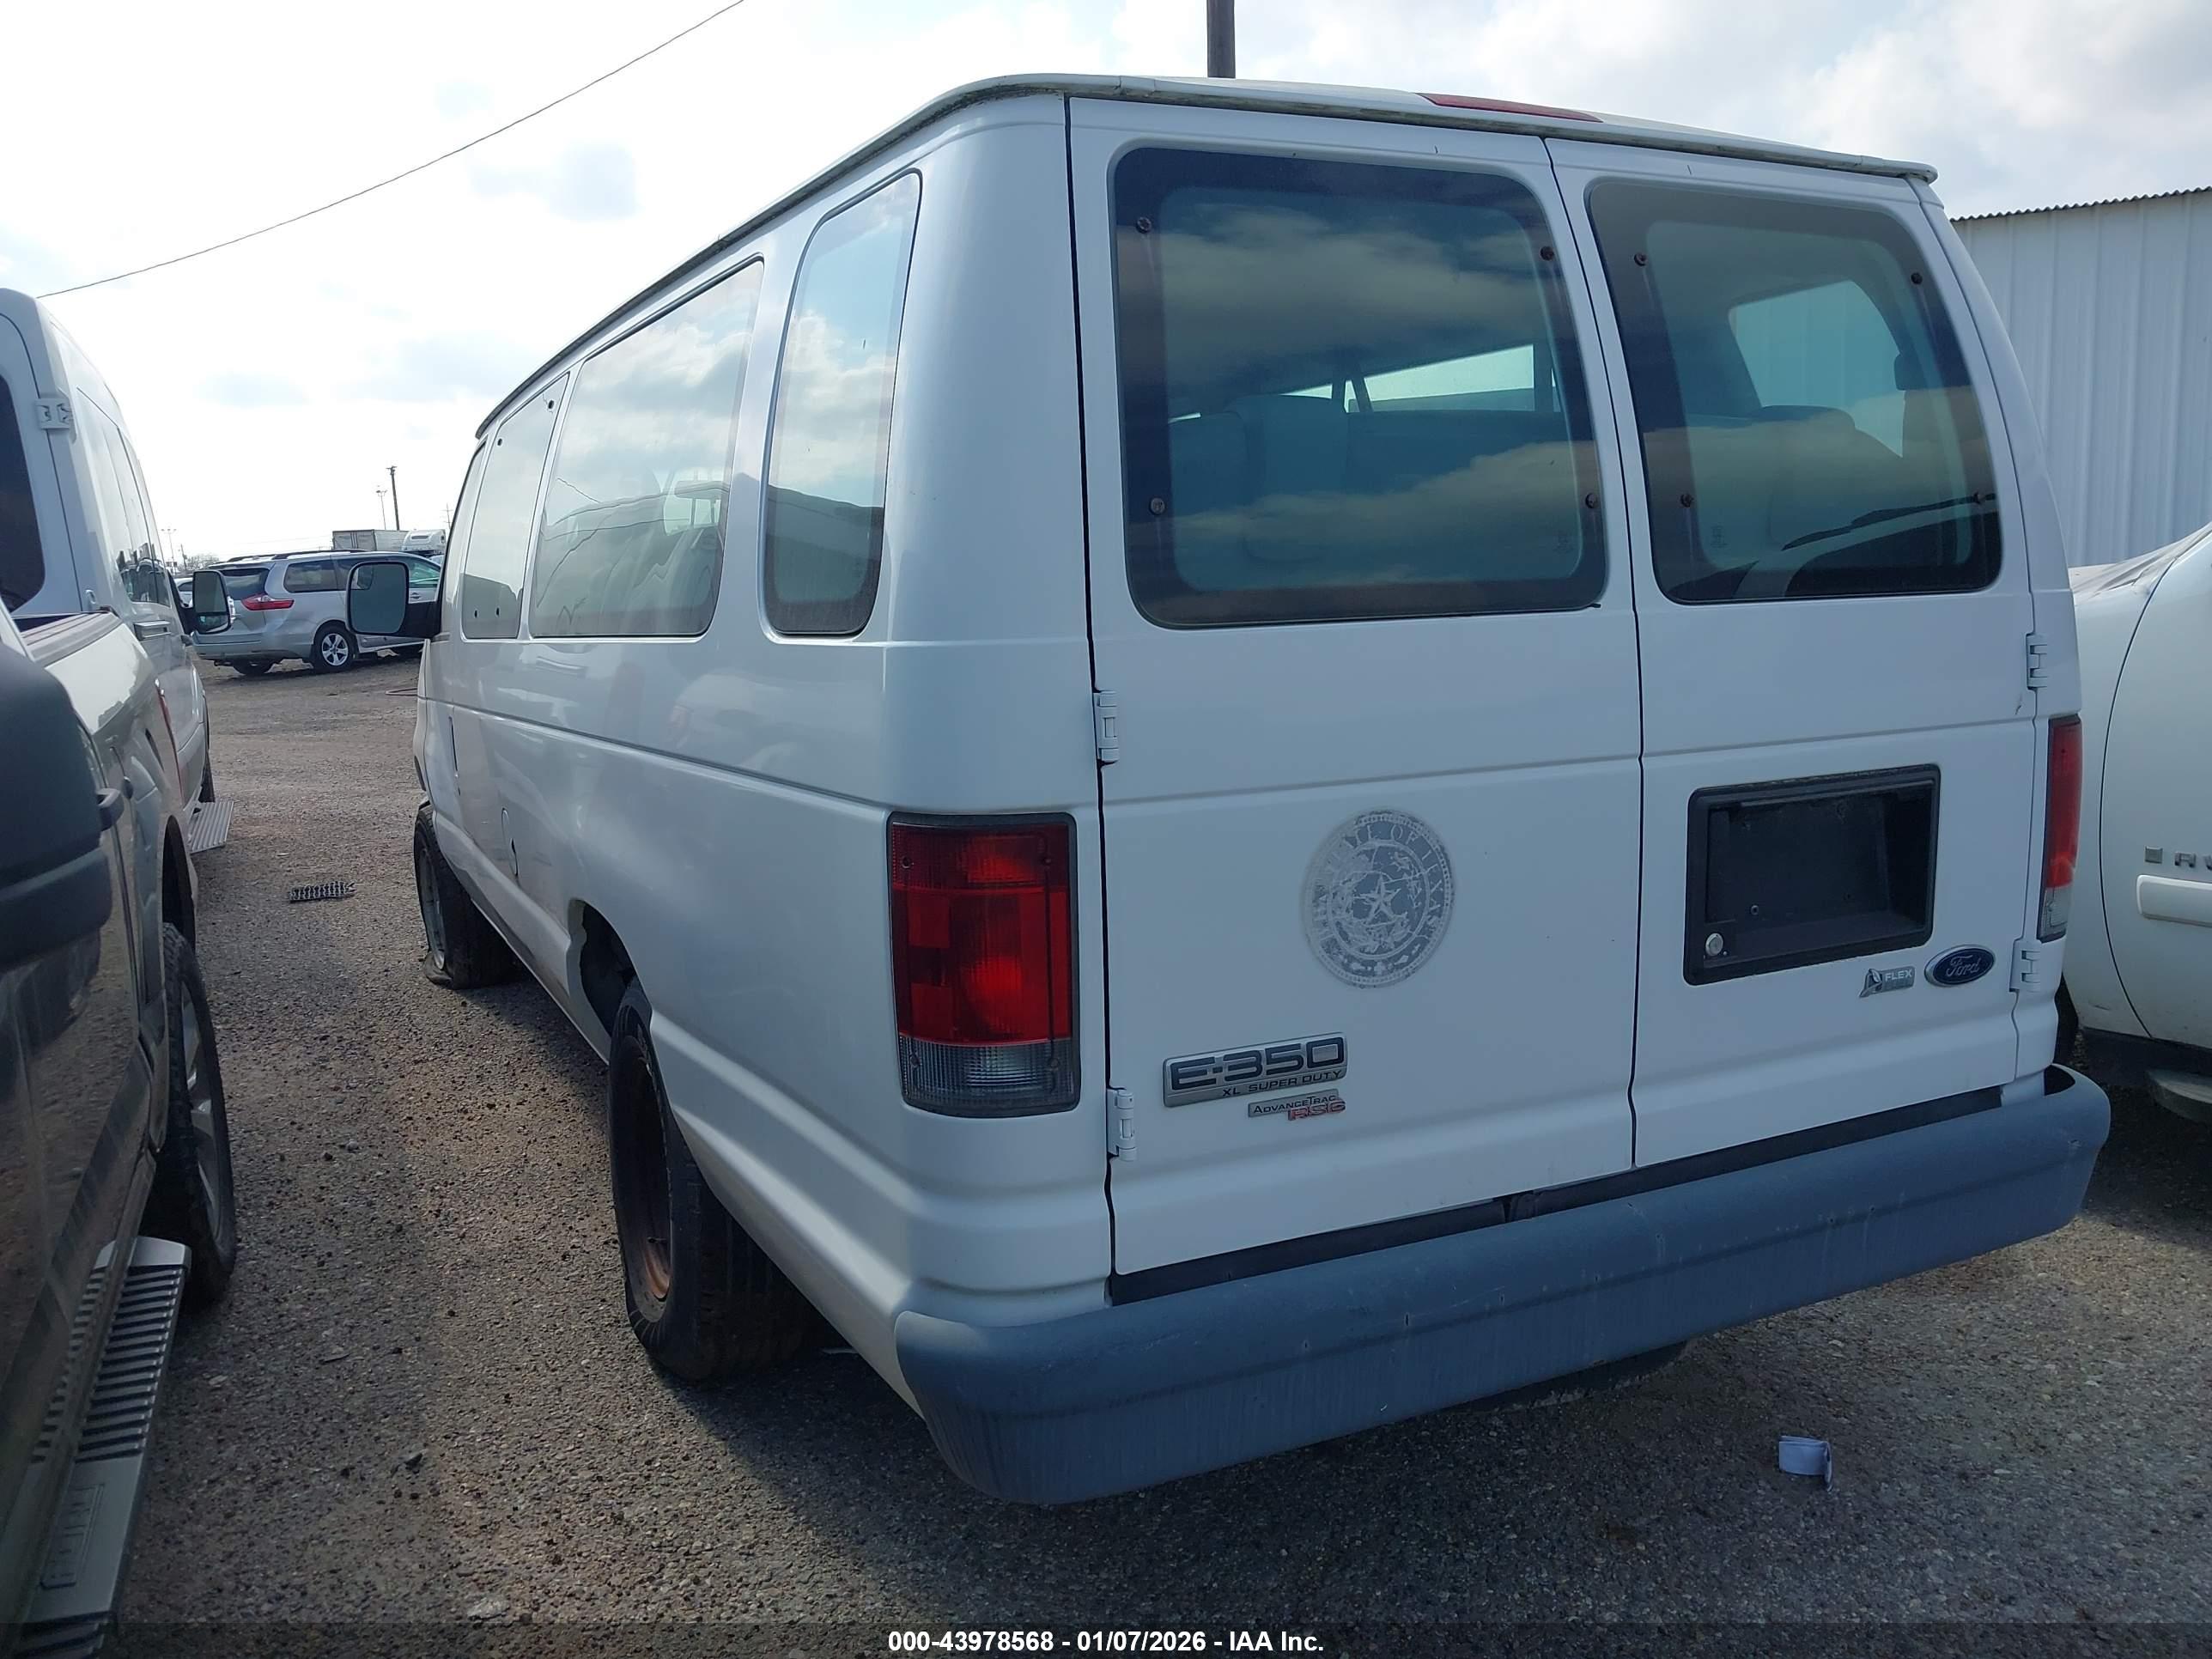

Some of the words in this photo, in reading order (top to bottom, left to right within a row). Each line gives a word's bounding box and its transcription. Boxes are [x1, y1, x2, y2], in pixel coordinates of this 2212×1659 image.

[1885, 969, 1912, 981] FLEX
[1945, 954, 1982, 978] Ford
[1170, 1036, 1345, 1091] E-350
[1222, 1087, 1241, 1097] XL
[1248, 1077, 1297, 1092] SUPER
[1302, 1069, 1342, 1084] DUTY
